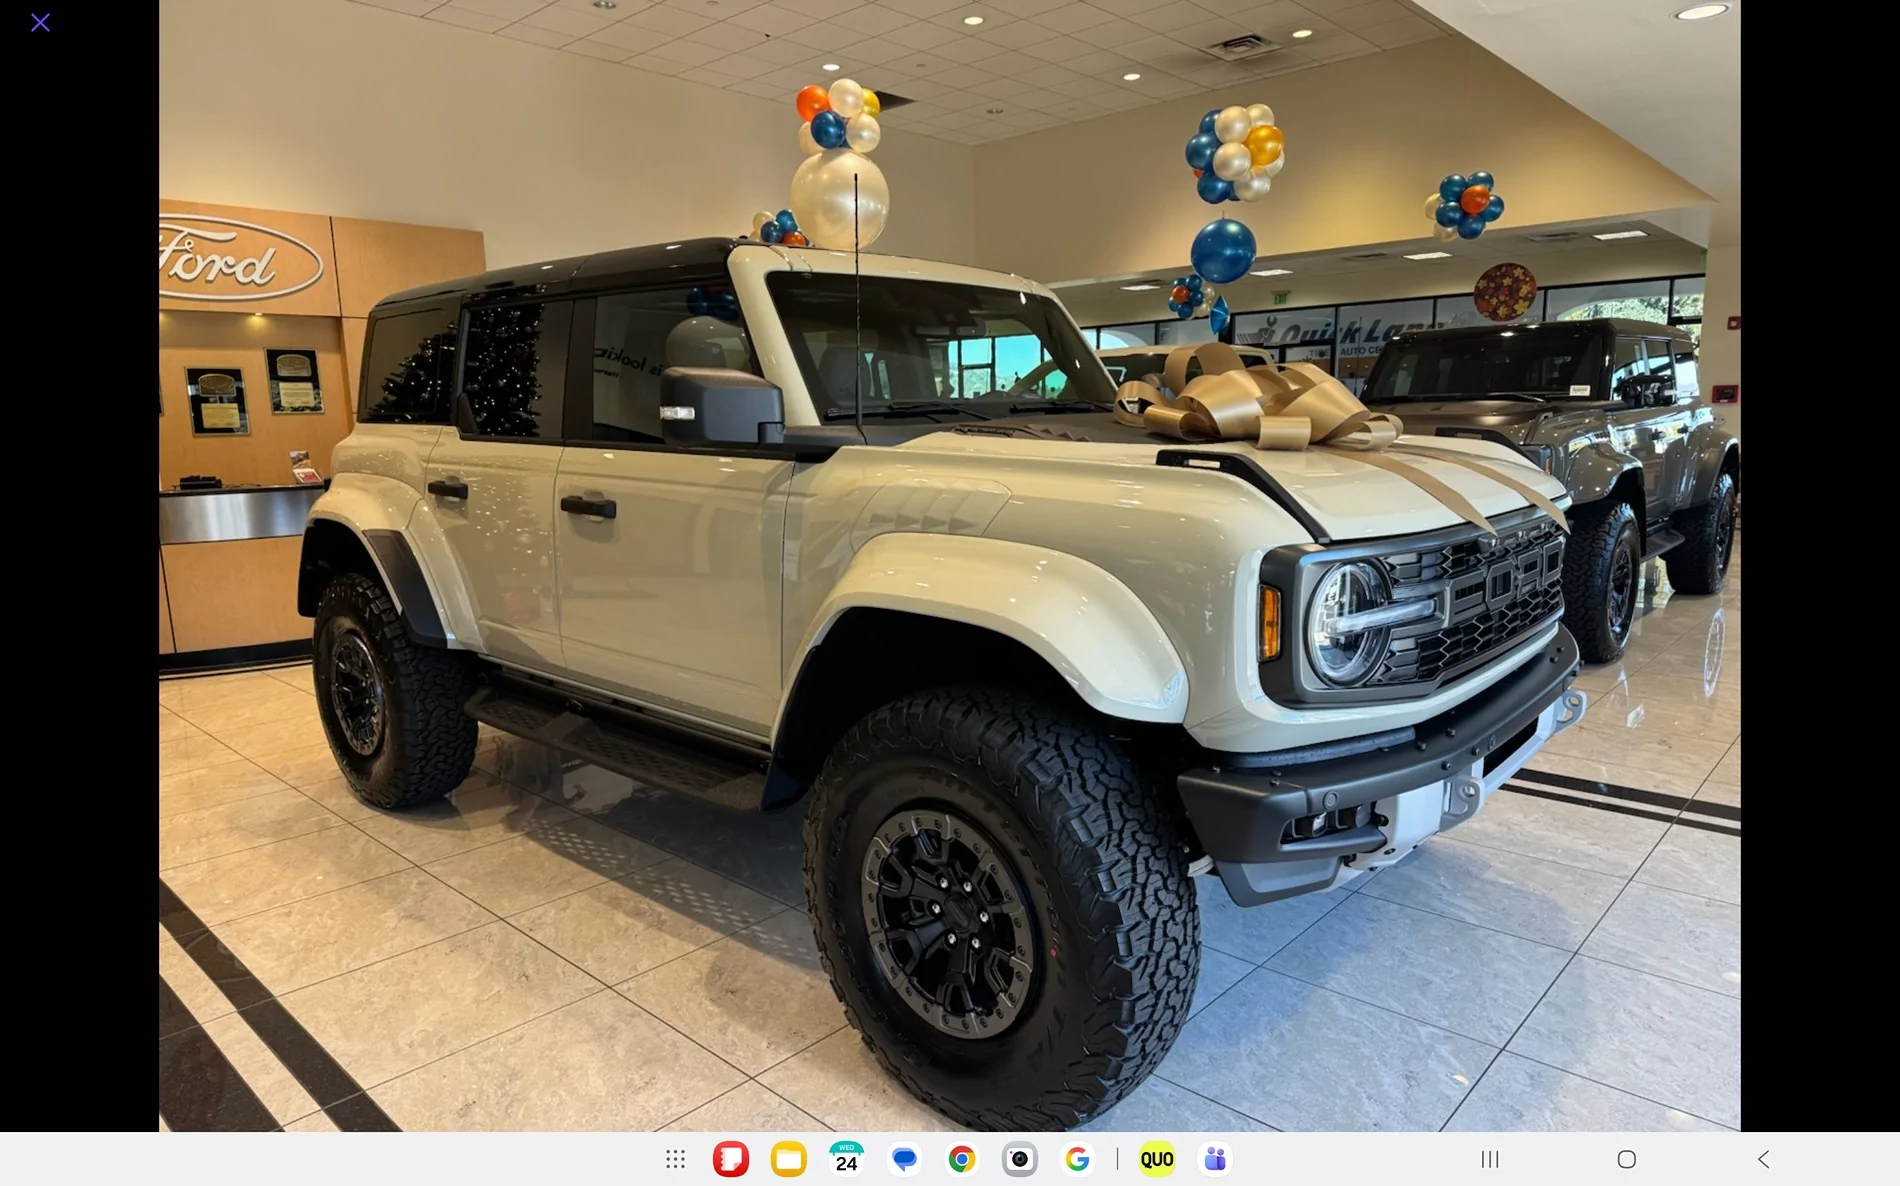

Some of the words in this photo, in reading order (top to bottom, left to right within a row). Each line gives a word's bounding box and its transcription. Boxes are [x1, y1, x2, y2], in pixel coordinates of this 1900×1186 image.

[159, 223, 276, 285] Ford
[1340, 346, 1366, 356] AUTO
[1363, 319, 1445, 343] La
[1447, 536, 1566, 627] FORD
